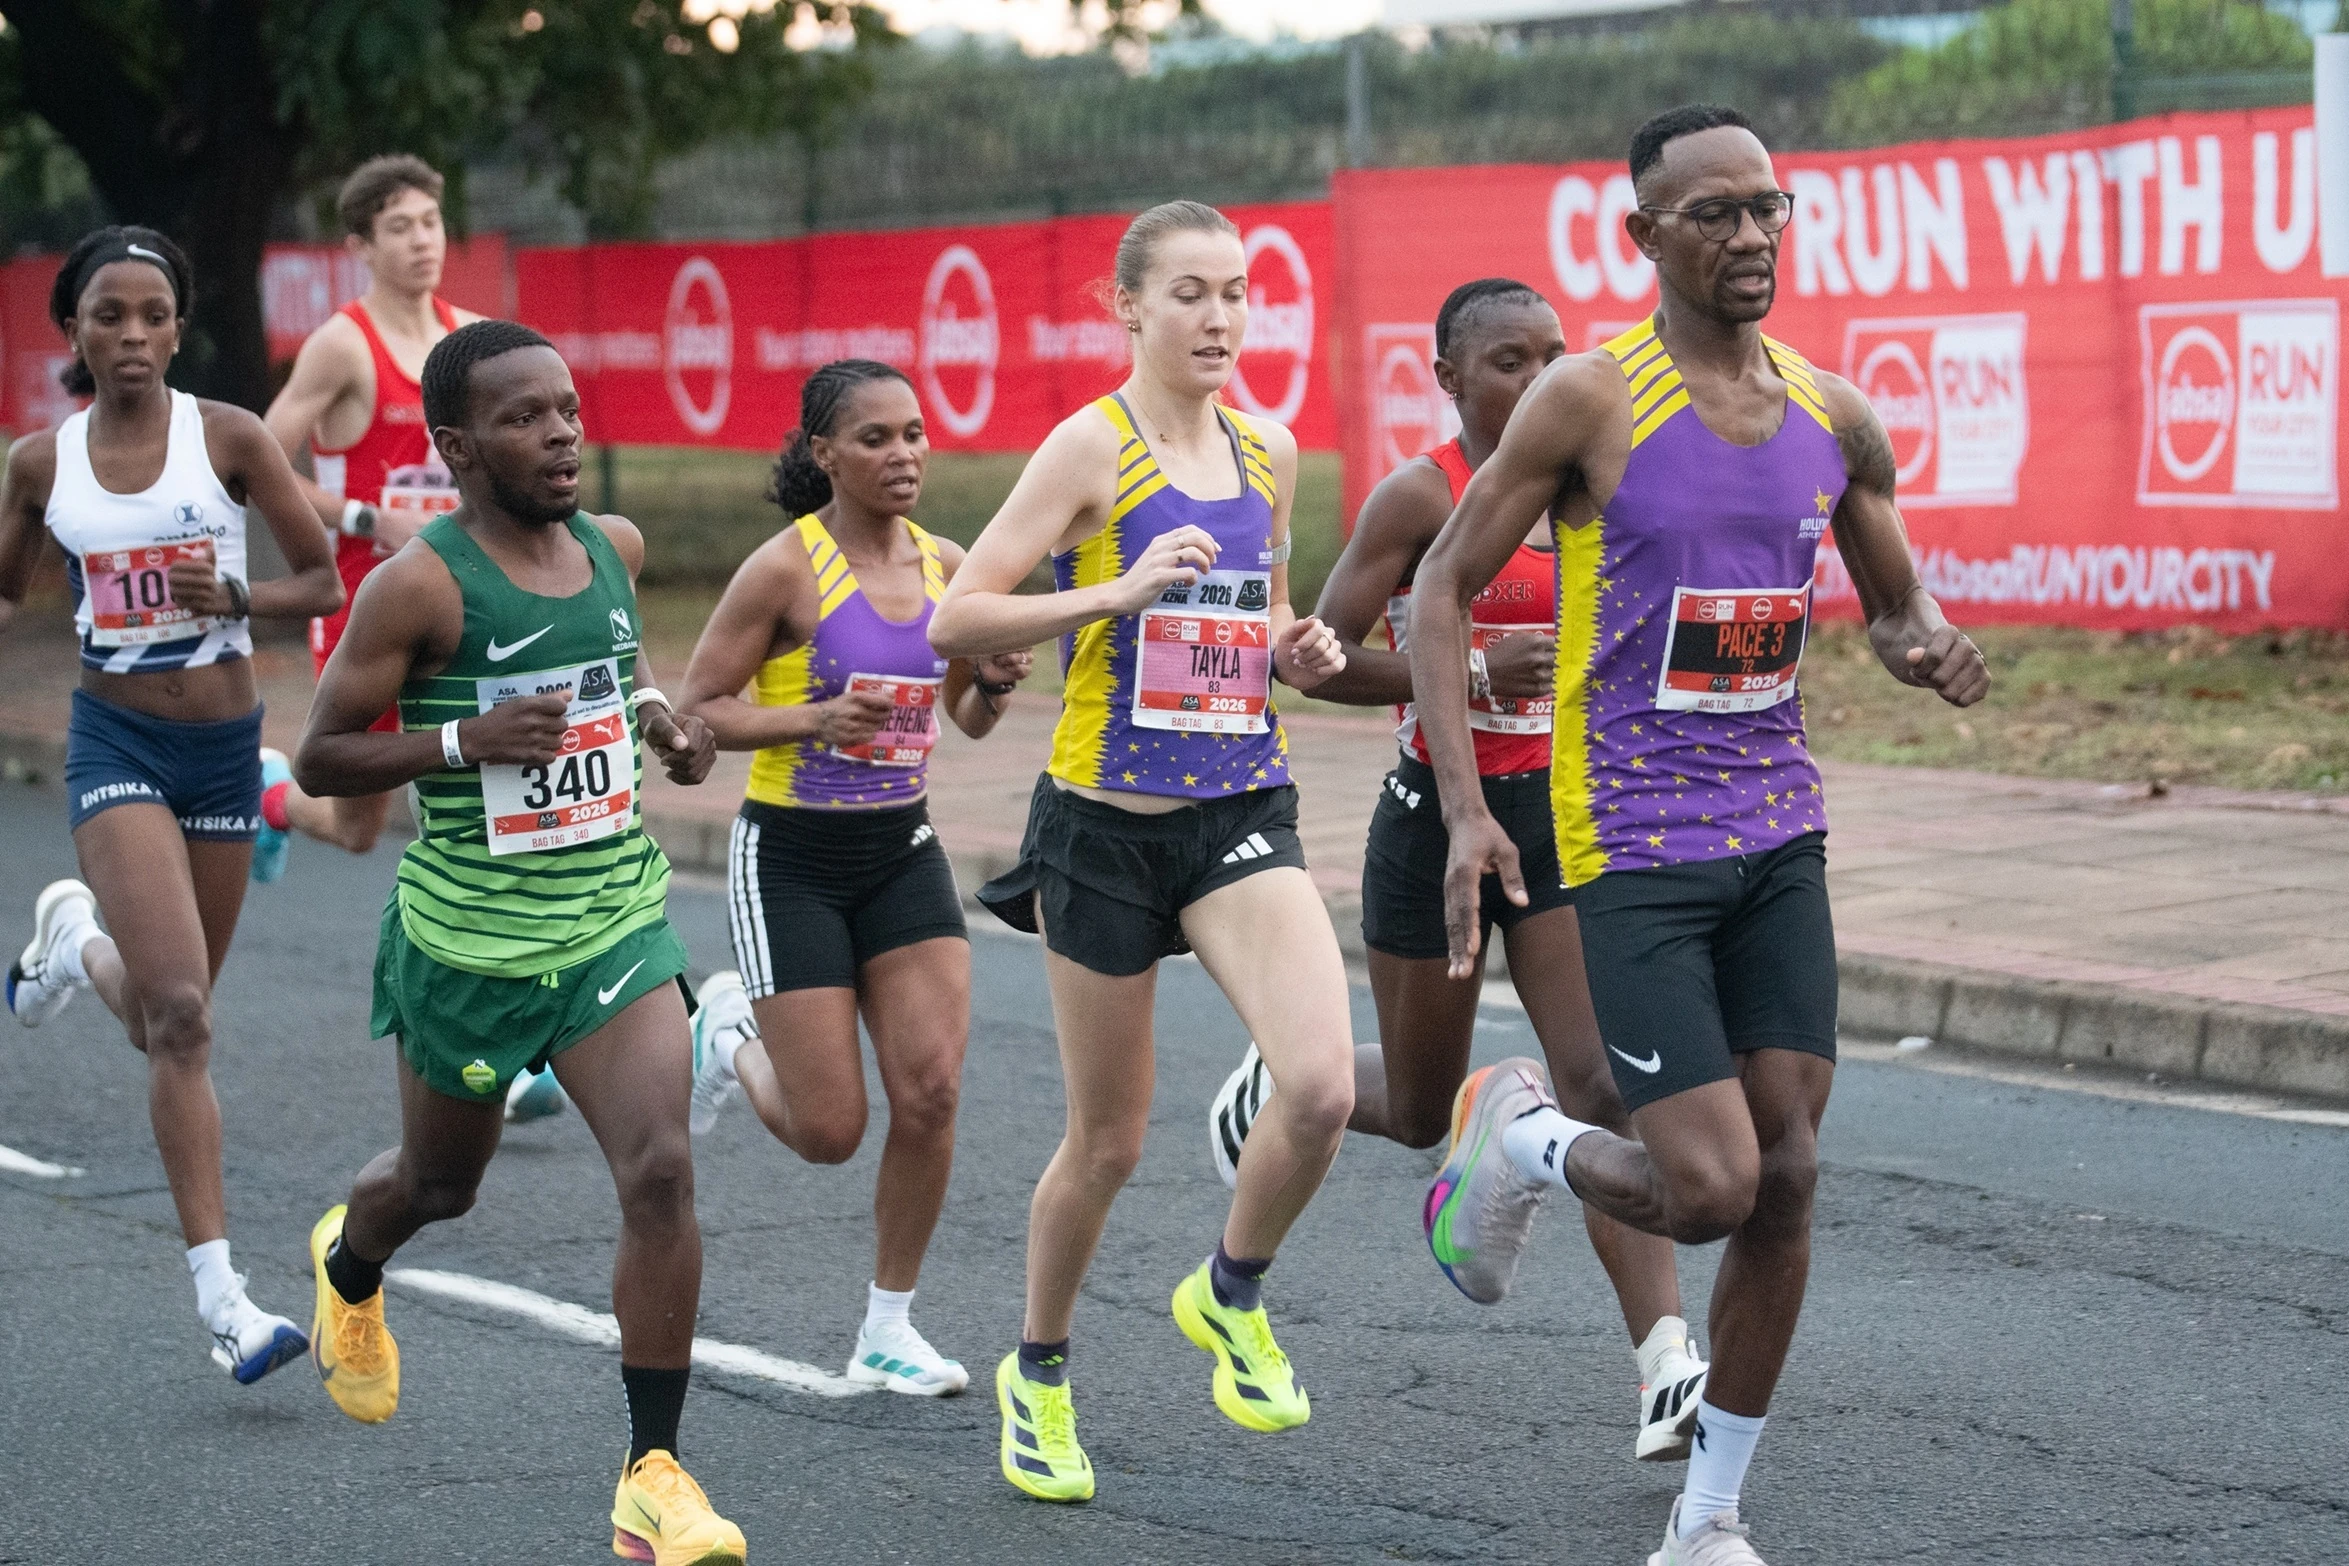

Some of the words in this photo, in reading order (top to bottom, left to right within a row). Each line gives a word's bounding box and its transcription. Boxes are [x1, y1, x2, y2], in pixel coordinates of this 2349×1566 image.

[1788, 164, 1970, 297] RUN
[1982, 134, 2223, 287] WITH
[2251, 127, 2316, 273] U
[2248, 341, 2324, 404] RUN
[1939, 356, 2012, 409] RUN
[113, 569, 174, 611] 10
[1198, 584, 1233, 605] 2026
[1240, 583, 1266, 598] ASA
[1472, 579, 1536, 604] OXER
[152, 608, 193, 624] 2026
[1753, 604, 1770, 613] absa
[1716, 623, 1765, 658] PACE
[1770, 623, 1787, 657] 3
[1189, 645, 1241, 680] TAYLA
[1741, 659, 1755, 674] 72
[582, 668, 610, 690] ASA
[1711, 677, 1731, 686] ASA
[1740, 673, 1780, 691] 2026
[497, 687, 518, 697] ASA
[1208, 681, 1221, 694] 83
[1182, 696, 1199, 705] ASA
[1209, 697, 1247, 713] 2026
[1526, 701, 1552, 714] 202
[1697, 698, 1715, 709] BAG
[1715, 699, 1731, 710] TAG
[1743, 698, 1754, 709] 72
[879, 705, 932, 734] EHENG
[1171, 717, 1187, 728] BAG
[1188, 718, 1202, 729] TAG
[1213, 719, 1224, 730] 83
[1487, 719, 1503, 730] BAG
[1503, 719, 1517, 731] TAG
[1528, 721, 1539, 731] 99
[893, 748, 924, 761] 2026
[521, 749, 611, 810] 340
[81, 781, 152, 810] ENTSIKA
[539, 813, 558, 825] ASA
[569, 801, 610, 823] 2026
[178, 815, 247, 831] NTSIKA
[531, 835, 549, 849] BAG
[549, 834, 565, 847] TAG
[573, 828, 589, 841] 340
